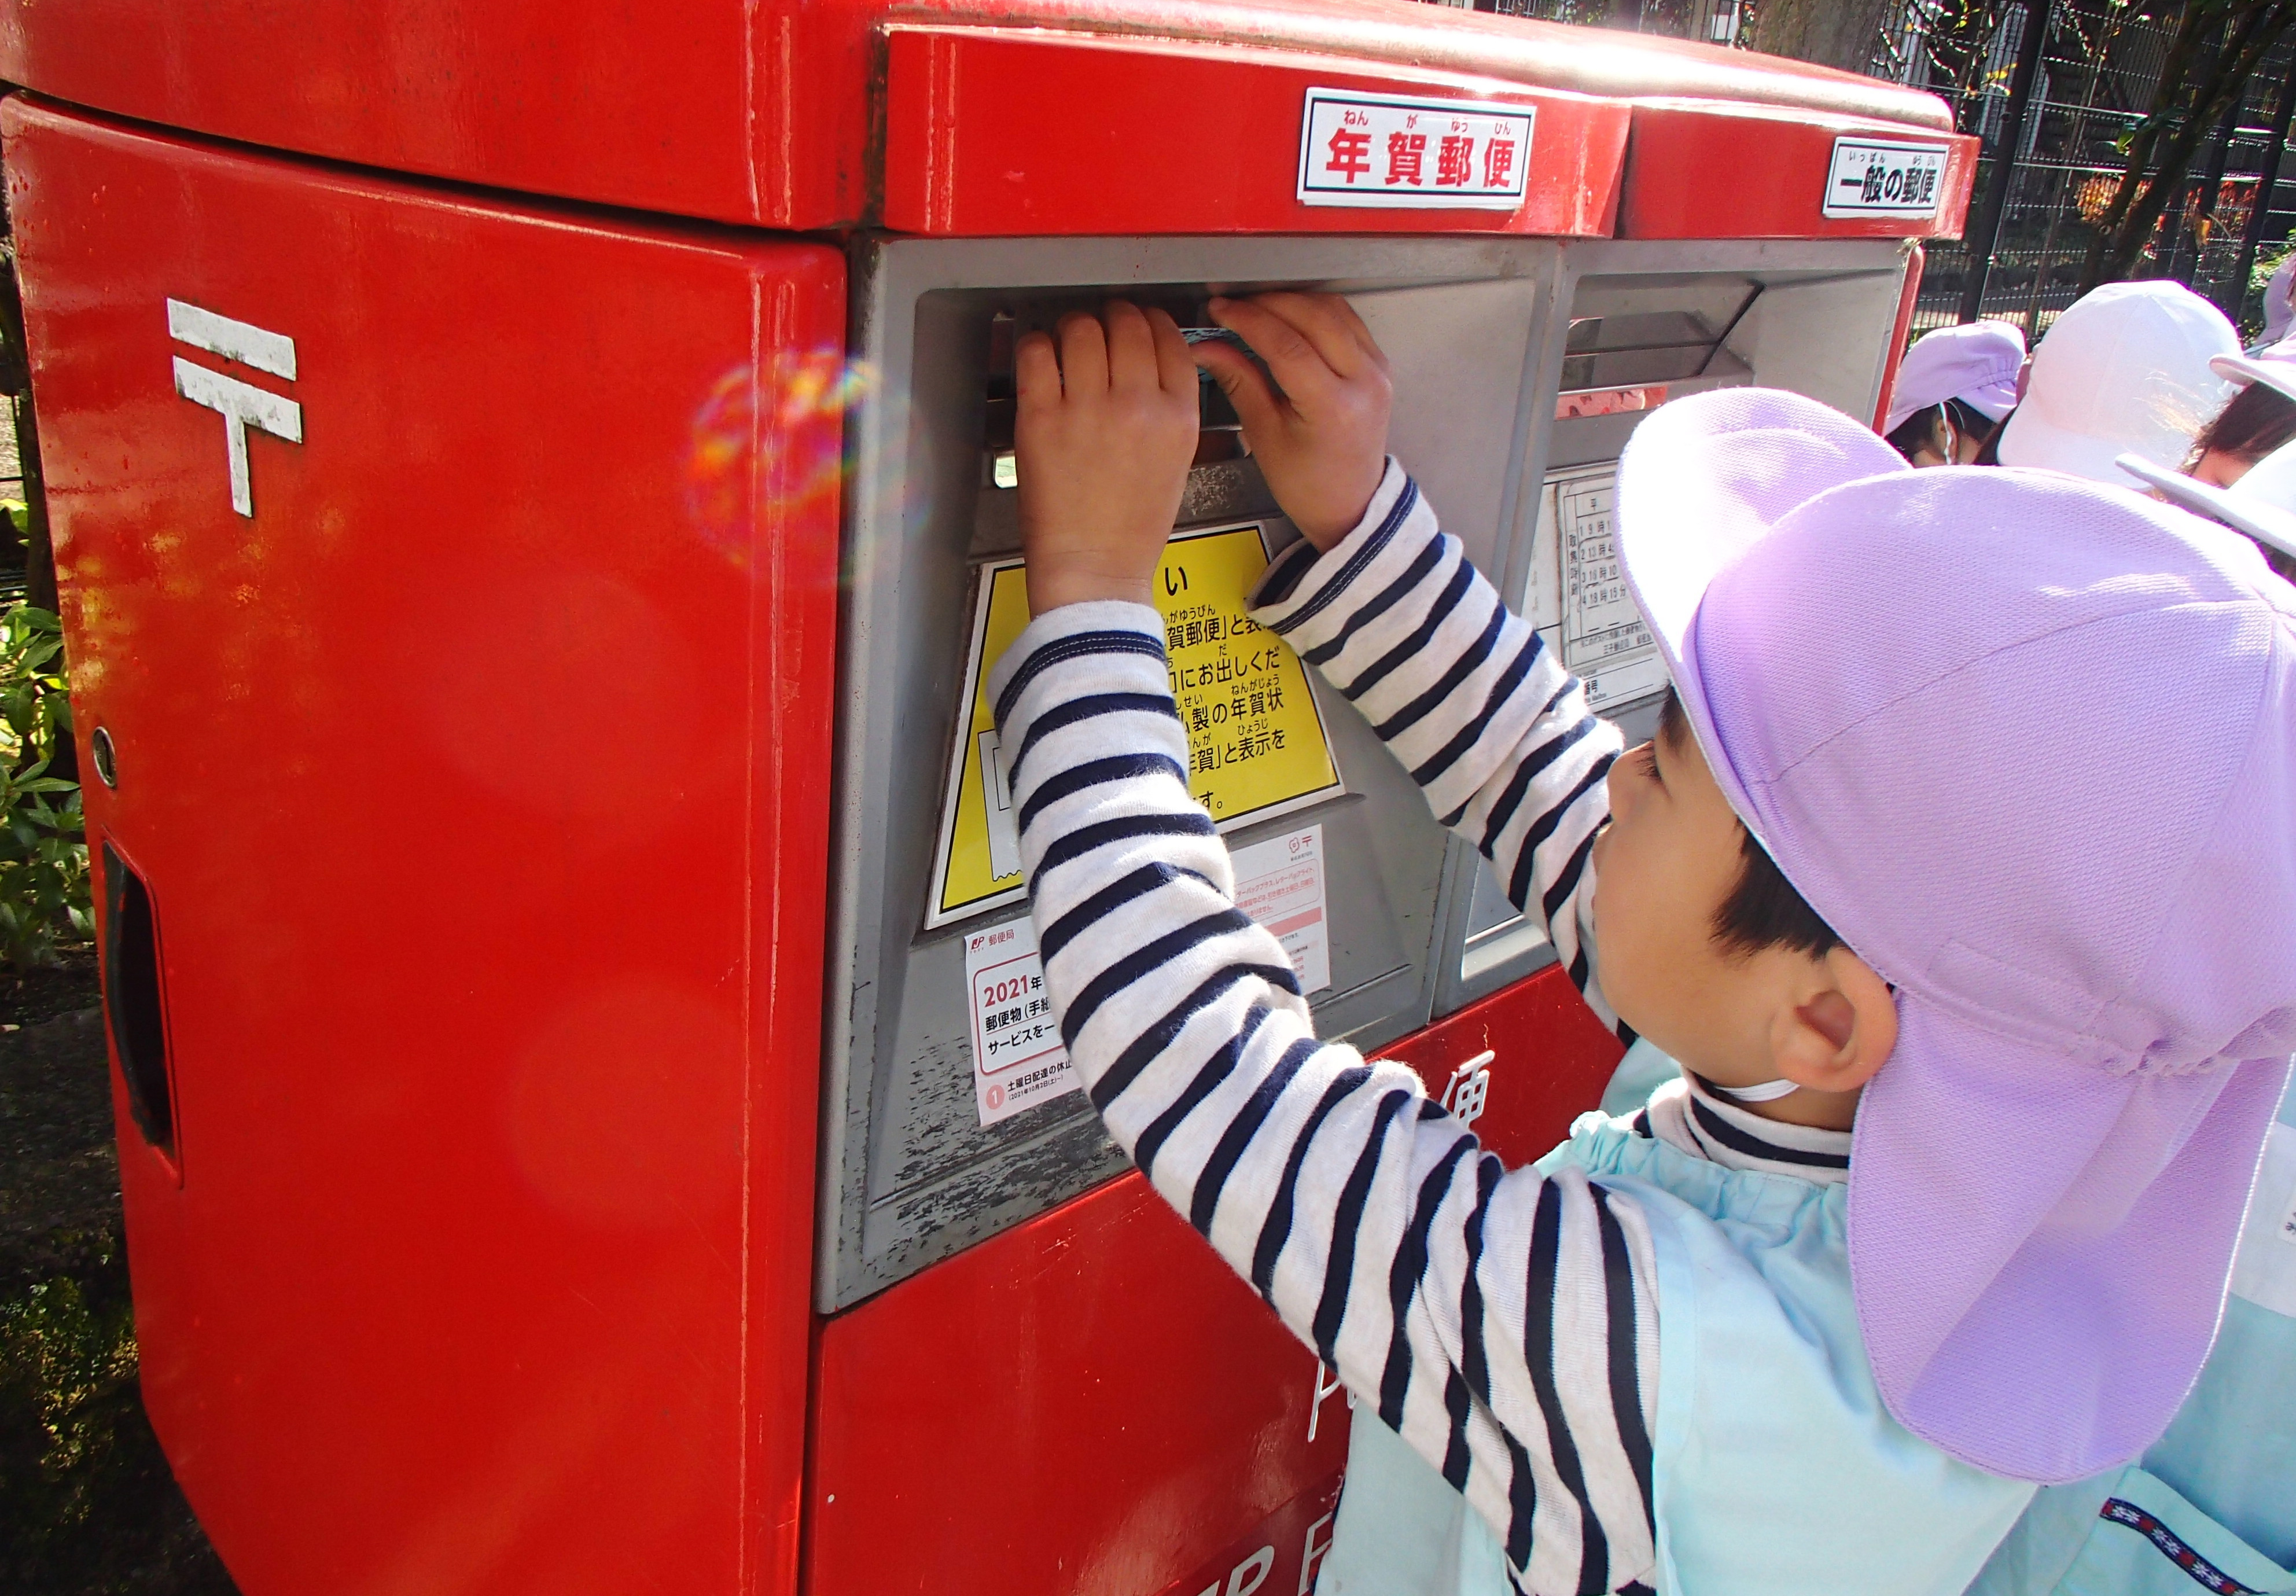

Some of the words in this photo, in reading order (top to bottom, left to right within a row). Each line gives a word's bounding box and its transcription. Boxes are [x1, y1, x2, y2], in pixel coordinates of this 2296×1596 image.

[1344, 109, 1368, 126] ねん
[1407, 114, 1418, 129] が
[1326, 127, 1515, 188] 年賀郵便
[1840, 164, 1937, 203] 一般の郵便
[1165, 566, 1188, 596] い
[1167, 614, 1270, 652] 賀郵便」と表
[1219, 643, 1227, 657] だ
[1231, 674, 1280, 696] ねんがじょう
[1237, 718, 1269, 736] ひょうじ
[1188, 731, 1212, 749] んが
[1193, 790, 1223, 811] す。
[989, 929, 1014, 946] 郵便局
[1308, 1360, 1357, 1442] P
